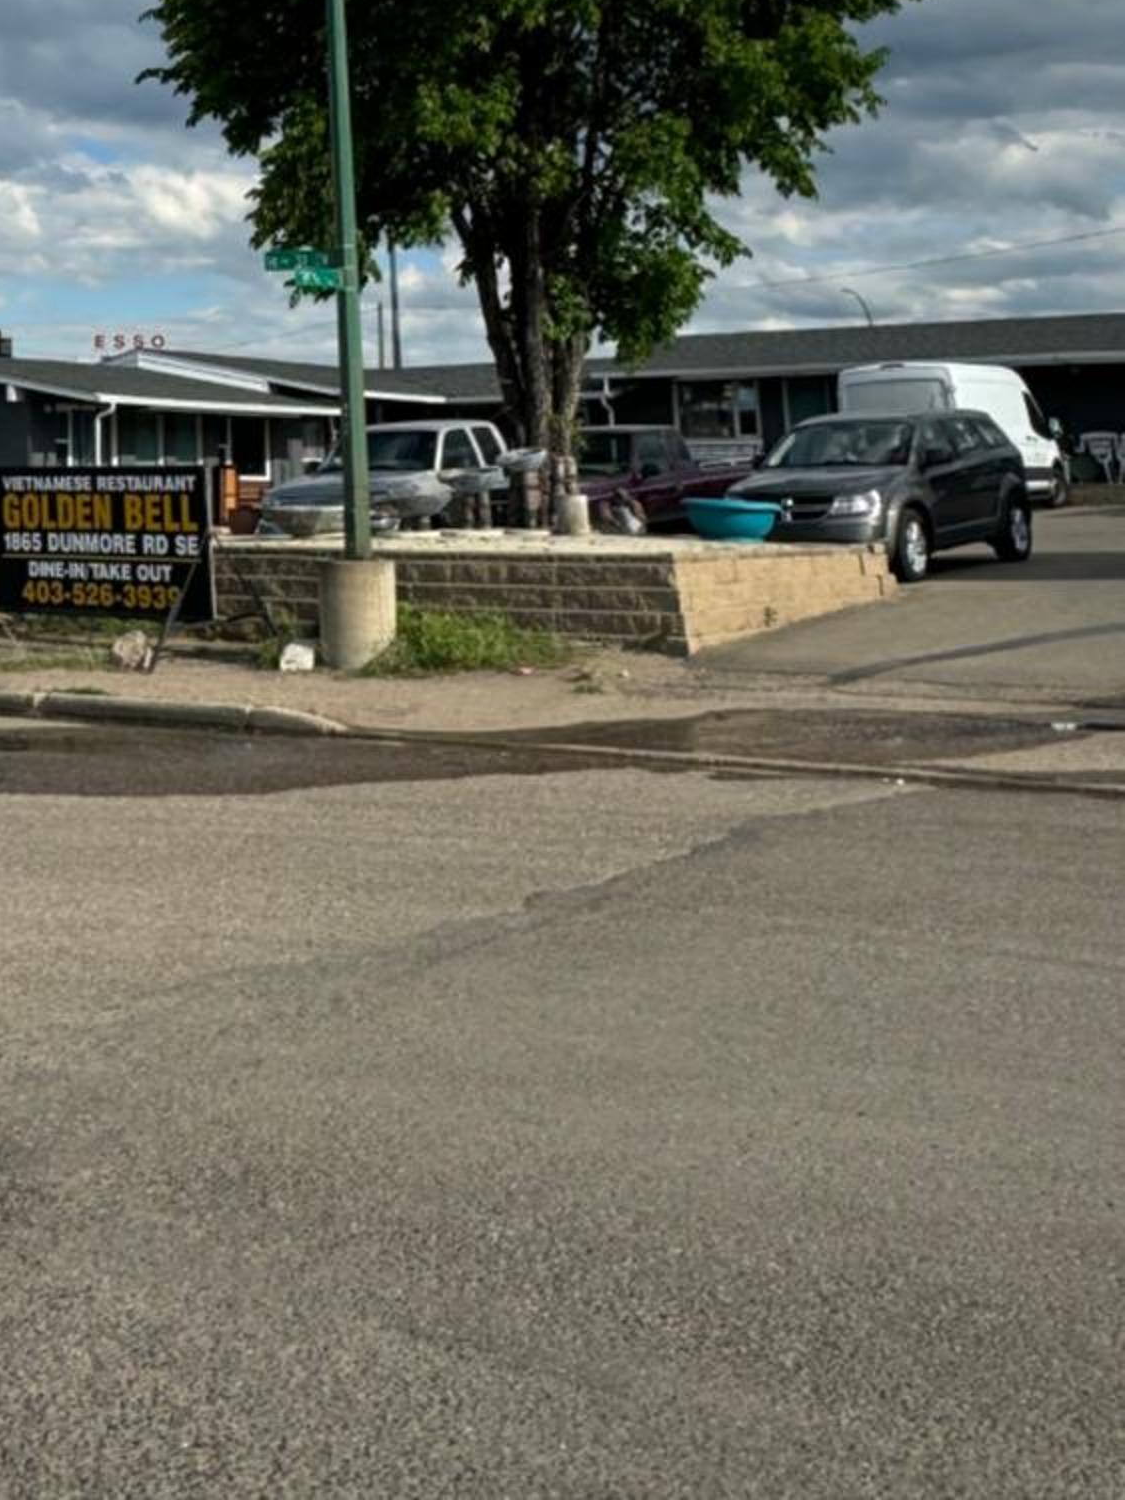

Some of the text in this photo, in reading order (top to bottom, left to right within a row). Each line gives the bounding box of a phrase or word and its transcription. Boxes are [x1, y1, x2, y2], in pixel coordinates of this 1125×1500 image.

[94, 334, 166, 349] ESSO
[2, 475, 197, 492] VIETNAMESE RESTAURANT
[2, 493, 198, 532] GOLDEN BELL
[3, 533, 200, 555] 1865 DUNMORE RD SE
[136, 565, 172, 582] OUT
